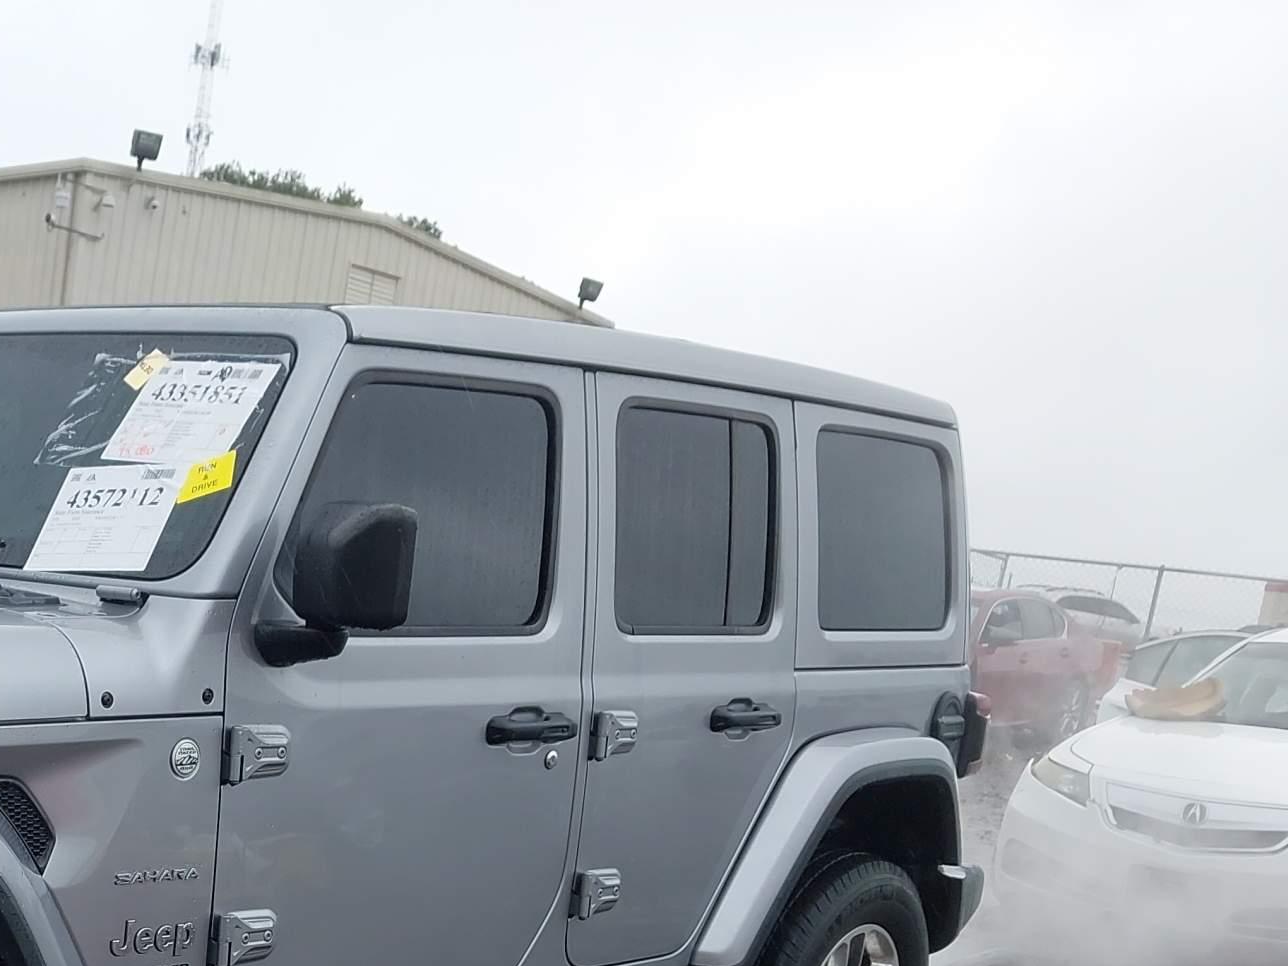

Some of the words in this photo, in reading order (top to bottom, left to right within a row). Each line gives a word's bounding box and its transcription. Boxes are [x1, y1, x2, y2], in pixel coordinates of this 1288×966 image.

[151, 382, 248, 405] 43351851
[191, 479, 218, 494] DRIVE
[66, 487, 164, 509] 43572112
[114, 867, 199, 885] SAHARA
[109, 919, 194, 957] Jeep
